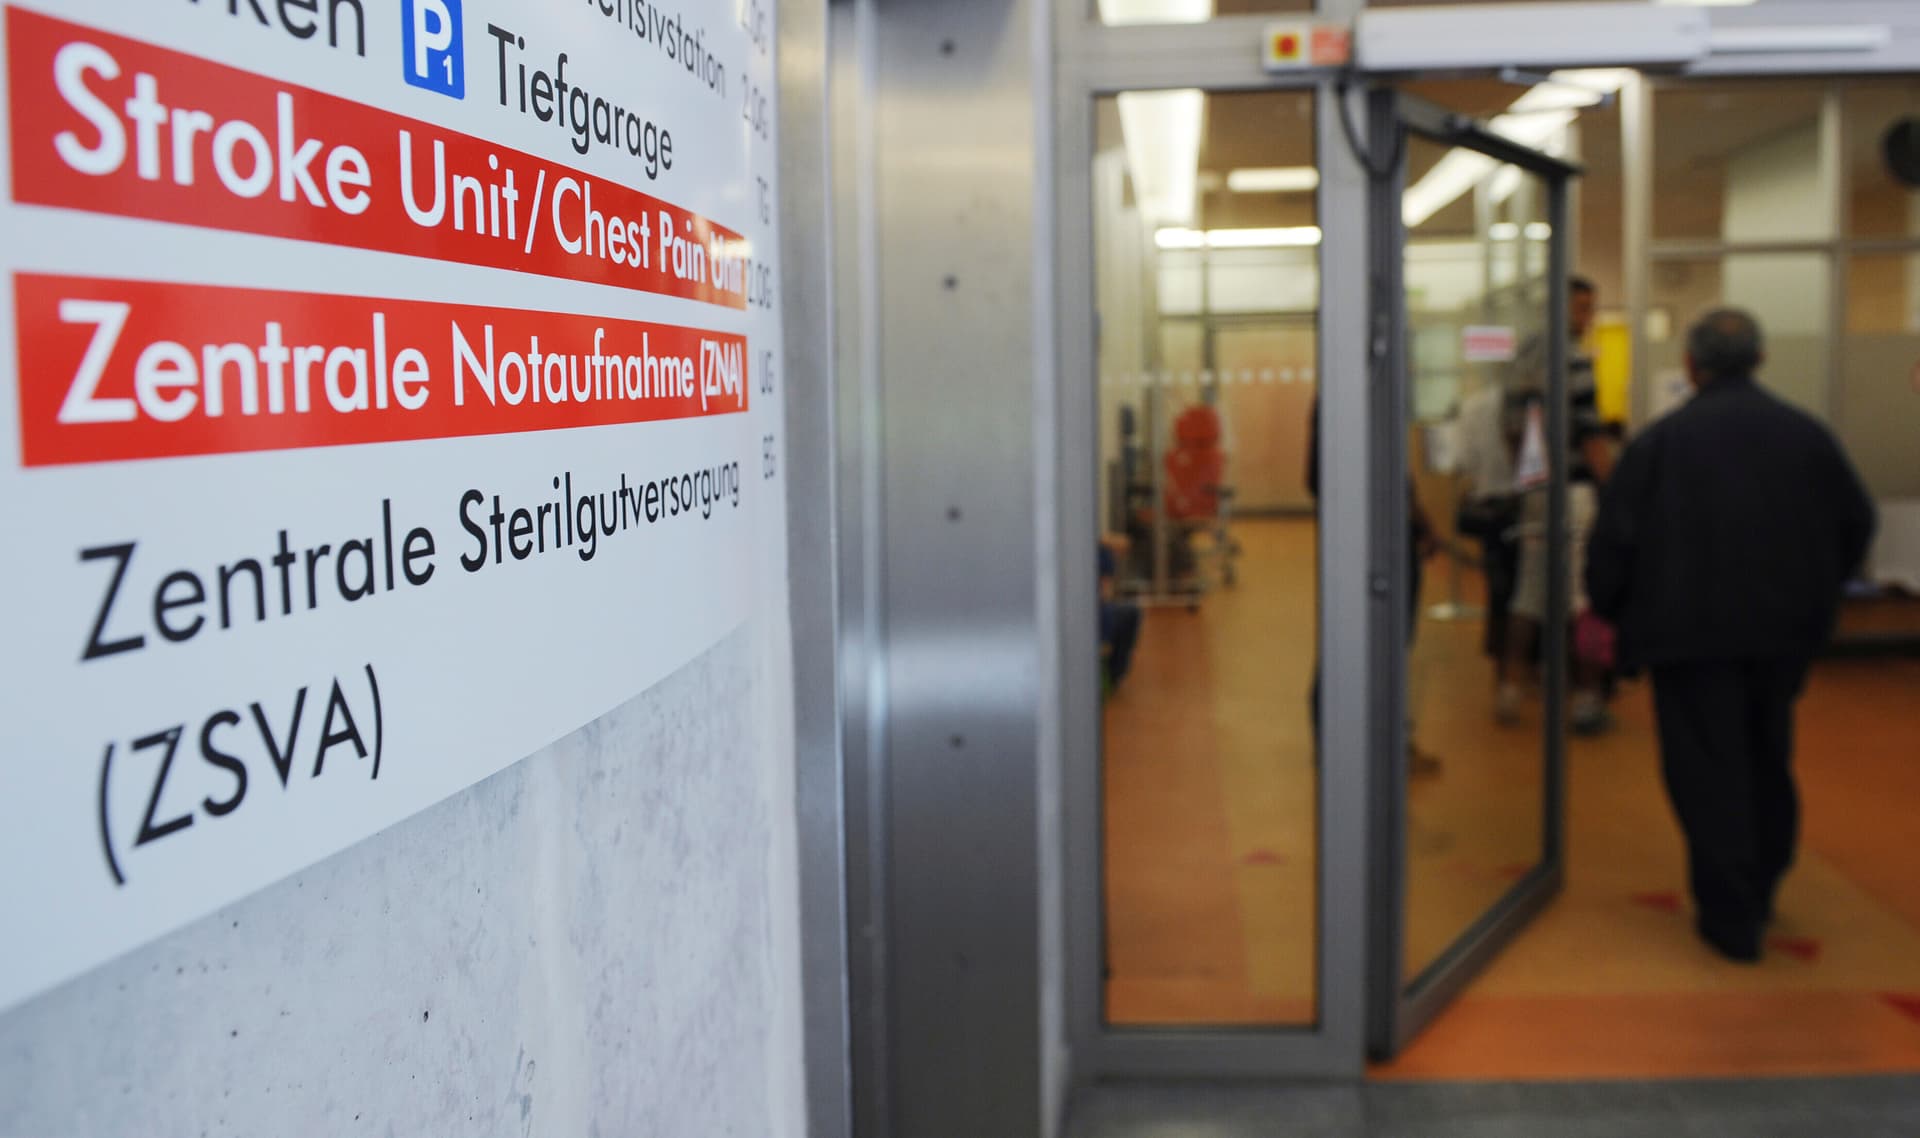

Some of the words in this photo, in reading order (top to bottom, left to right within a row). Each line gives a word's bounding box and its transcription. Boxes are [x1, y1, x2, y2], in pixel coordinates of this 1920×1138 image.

[54, 41, 372, 215] Stroke
[659, 211, 706, 284] Pain
[488, 22, 672, 180] Tiefgarage
[57, 298, 430, 425] Zentrale
[452, 319, 695, 407] Notaufnahme
[700, 338, 743, 411] (ZNA)
[79, 498, 436, 662] Zentrale
[459, 461, 739, 572] Sterilgutversorgung
[97, 663, 383, 886] (ZSVA)
